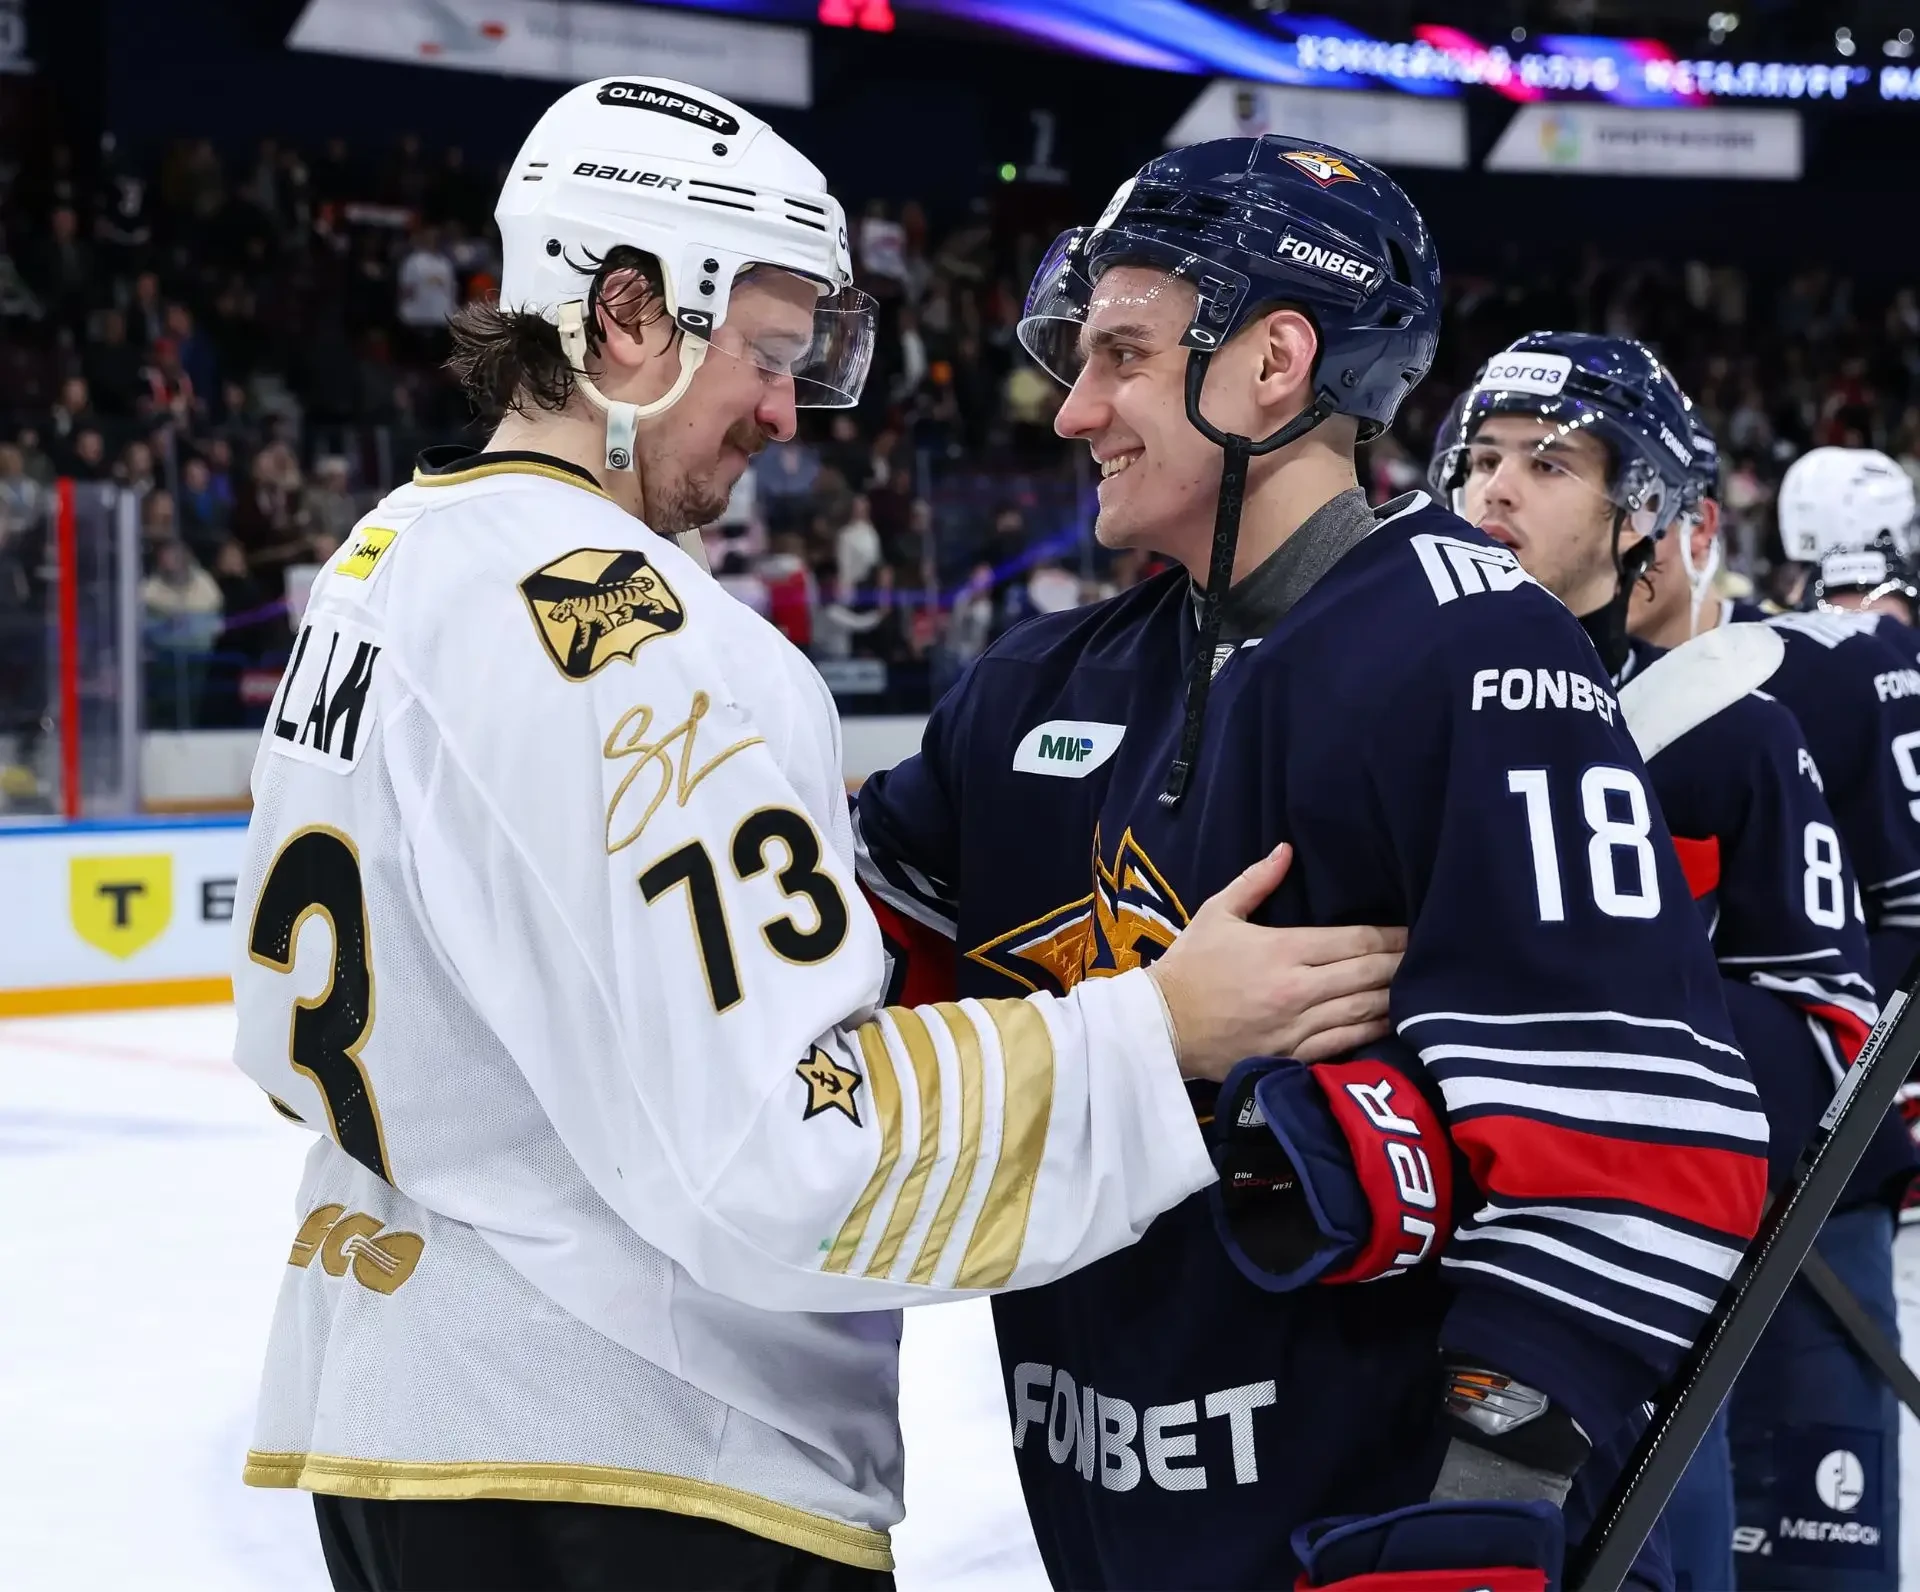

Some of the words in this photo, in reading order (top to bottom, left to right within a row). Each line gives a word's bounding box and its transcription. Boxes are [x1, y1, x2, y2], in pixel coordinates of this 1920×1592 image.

[609, 87, 729, 129] OLIMPBET
[572, 162, 683, 192] BAUER
[1277, 235, 1375, 284] FONBET
[1472, 668, 1619, 728] FONBET
[1507, 766, 1661, 919] 18
[638, 803, 851, 1015] 73
[1856, 1019, 1888, 1069] STARKY
[1012, 1361, 1278, 1492] FONBET
